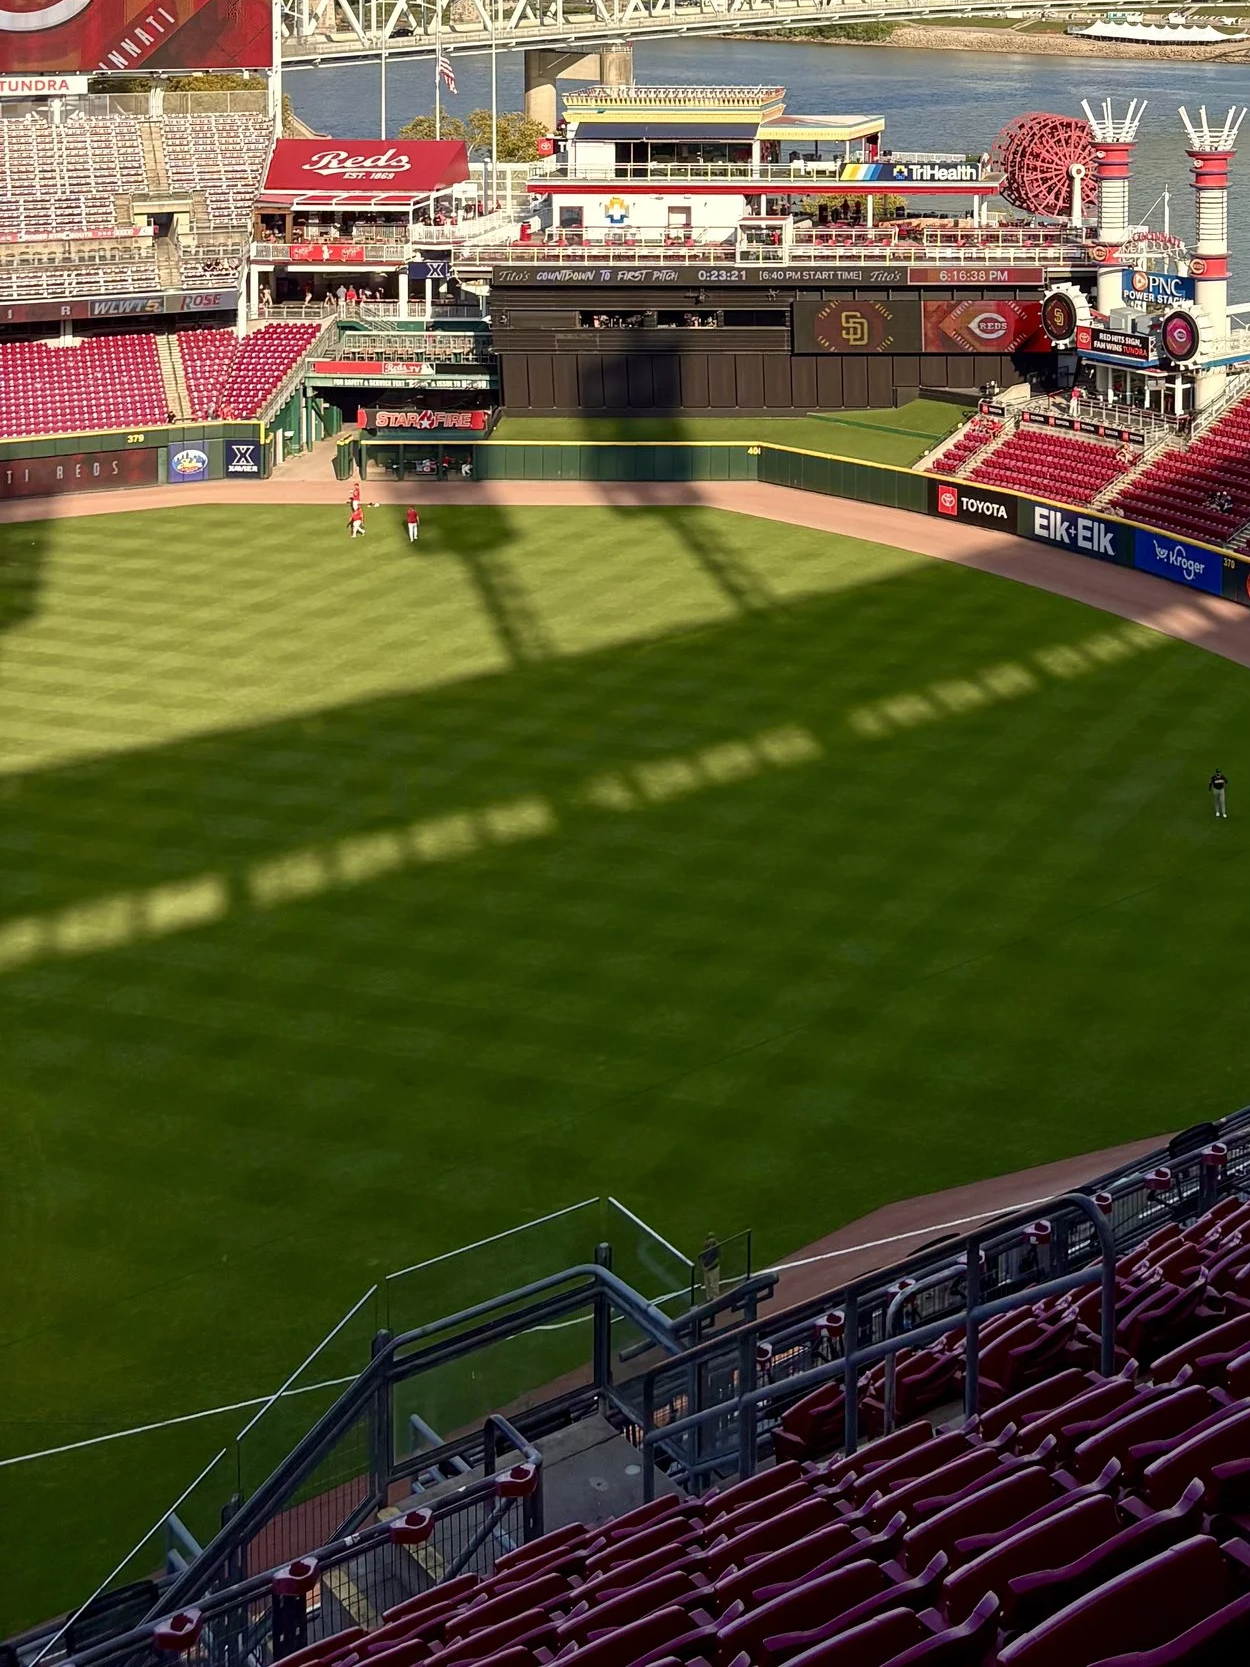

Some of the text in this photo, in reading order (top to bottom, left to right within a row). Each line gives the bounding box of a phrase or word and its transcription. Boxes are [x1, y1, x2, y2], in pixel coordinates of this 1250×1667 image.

[0, 79, 70, 92] TUNDRA
[302, 149, 411, 176] Reds
[343, 172, 395, 180] EST. 1869
[908, 165, 977, 181] TriHealth
[498, 270, 747, 282] Tito's COUNTDOWN TO FIRST PITCH 0:23:21
[785, 271, 801, 280] PM
[802, 271, 831, 280] START
[870, 270, 901, 282] Tito's
[939, 270, 1008, 282] 6:16:38 PM
[1148, 275, 1182, 296] PNC
[180, 294, 221, 311] ROSE
[1123, 289, 1155, 303] POWER
[979, 321, 1008, 330] REDS
[1099, 332, 1111, 342] RED
[1111, 334, 1125, 344] HITS
[1093, 340, 1148, 357] FAN WINS TUNDRA
[375, 410, 471, 428] STAR FIRE
[127, 433, 144, 444] 379
[228, 465, 258, 473] XAVIER
[961, 497, 1008, 519] TOYOTA
[1034, 506, 1115, 556] Elk+Elk
[1169, 545, 1205, 580] Kroger
[1223, 557, 1236, 570] 370
